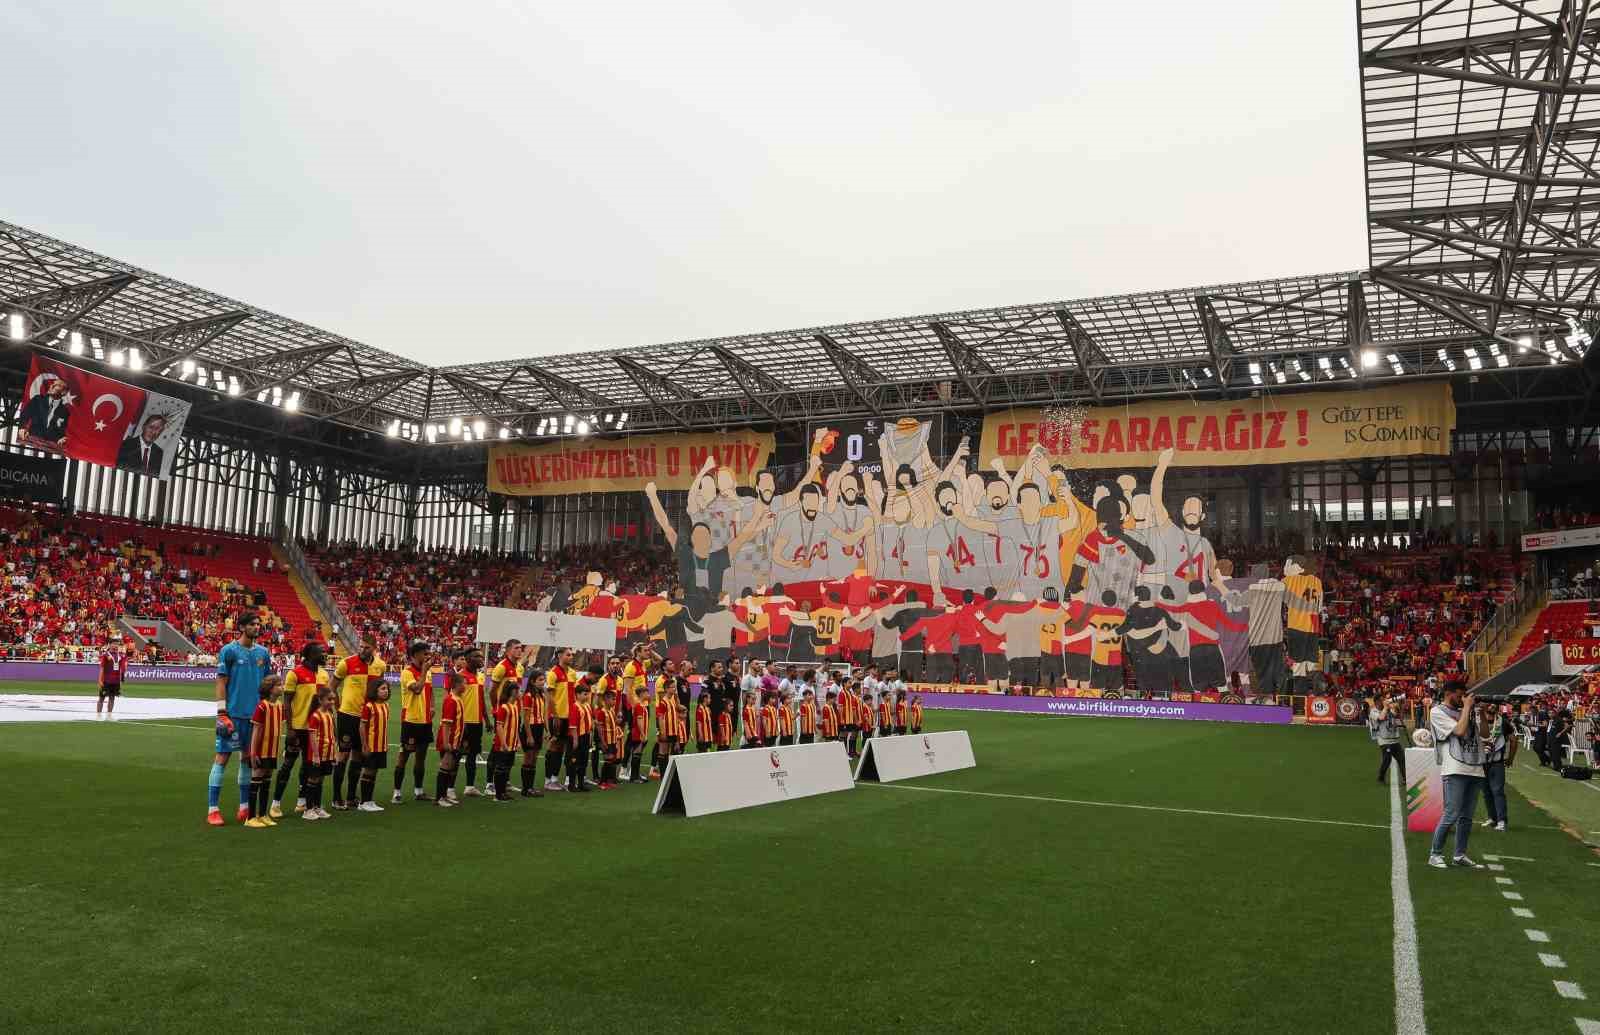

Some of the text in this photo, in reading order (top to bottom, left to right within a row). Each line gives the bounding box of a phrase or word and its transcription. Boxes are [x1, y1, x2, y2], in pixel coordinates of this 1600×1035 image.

[1360, 423, 1441, 442] COMING
[846, 434, 863, 461] 0
[666, 447, 680, 477] O
[817, 615, 835, 634] 50
[1565, 643, 1585, 659] GÖZ
[1047, 701, 1185, 716] www.birfikirmedya.com
